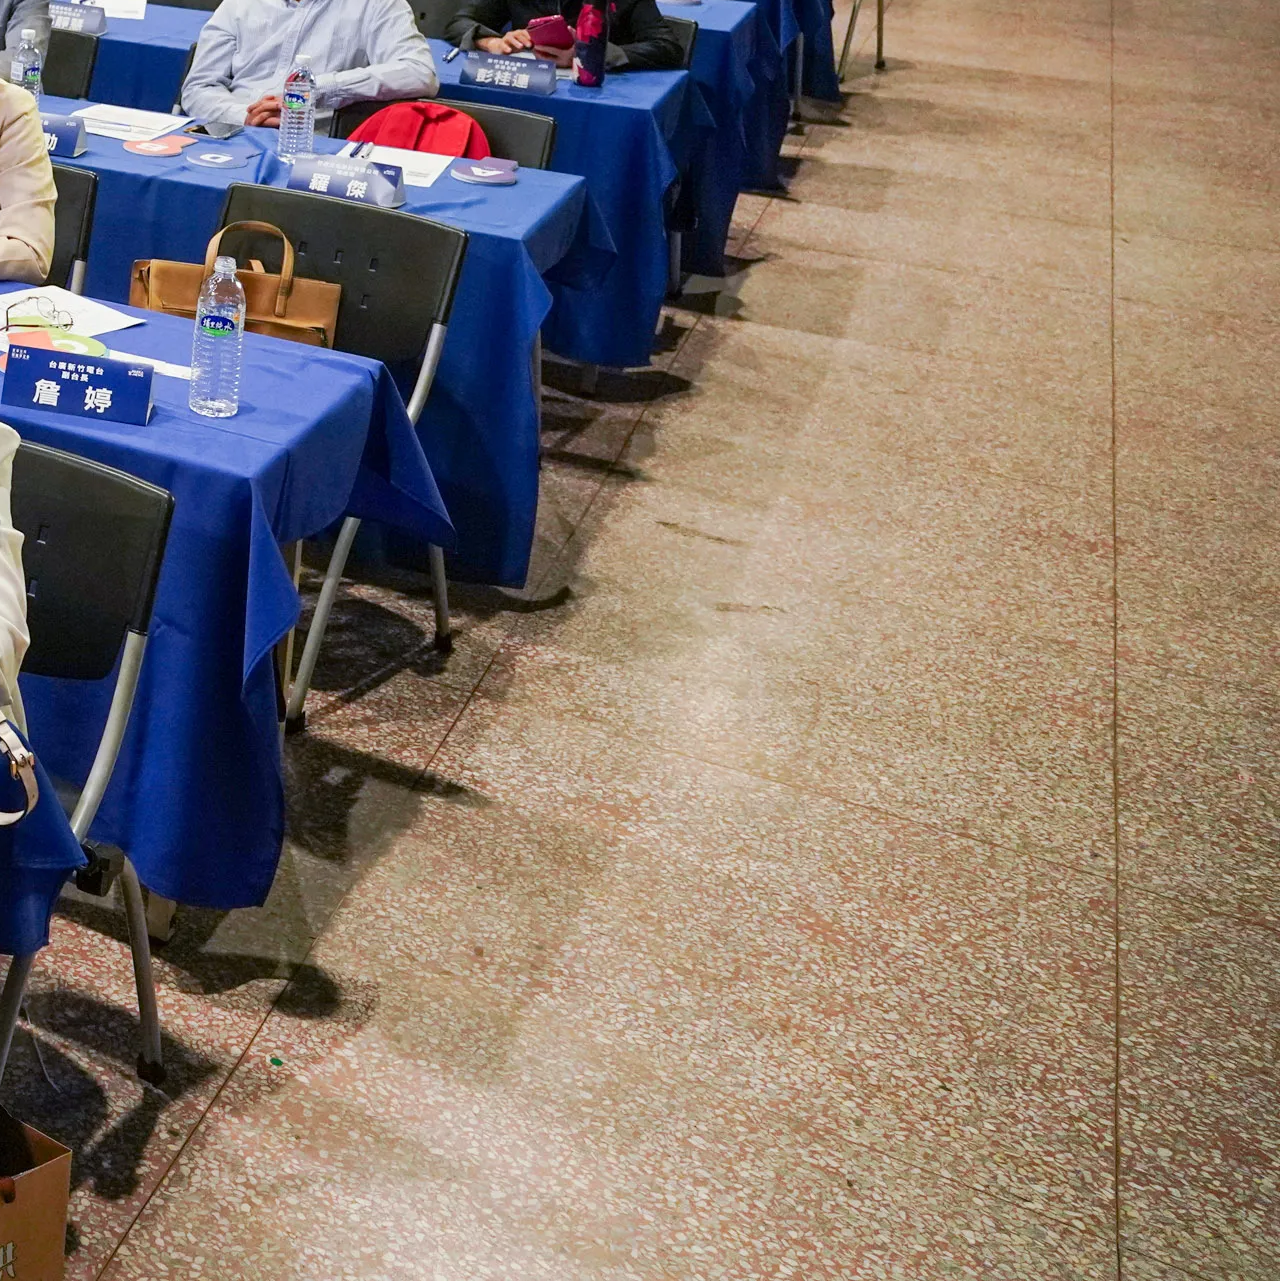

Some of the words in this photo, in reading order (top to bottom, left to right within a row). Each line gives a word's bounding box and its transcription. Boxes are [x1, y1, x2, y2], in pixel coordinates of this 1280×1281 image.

[48, 360, 105, 376] 台廣新竹電台
[61, 371, 89, 382] 副台長
